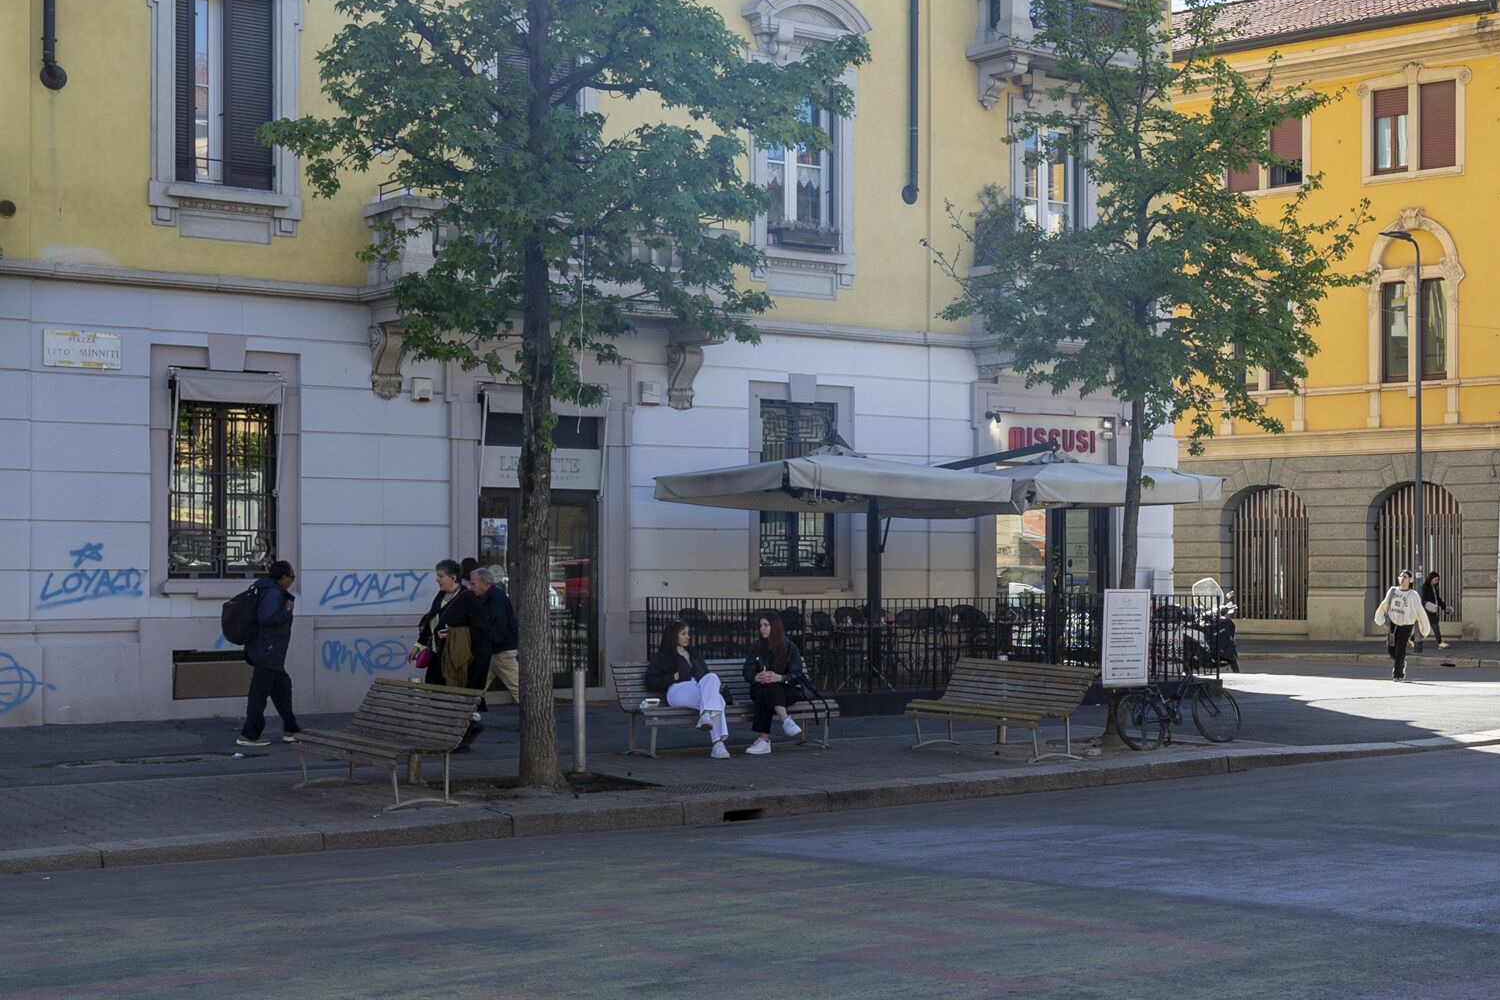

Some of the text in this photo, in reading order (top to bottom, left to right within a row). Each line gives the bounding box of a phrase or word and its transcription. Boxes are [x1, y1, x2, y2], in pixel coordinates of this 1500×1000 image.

[68, 335, 97, 344] PIAZZA
[45, 347, 119, 359] TITO MINNITI
[320, 570, 429, 606] LOYALTY
